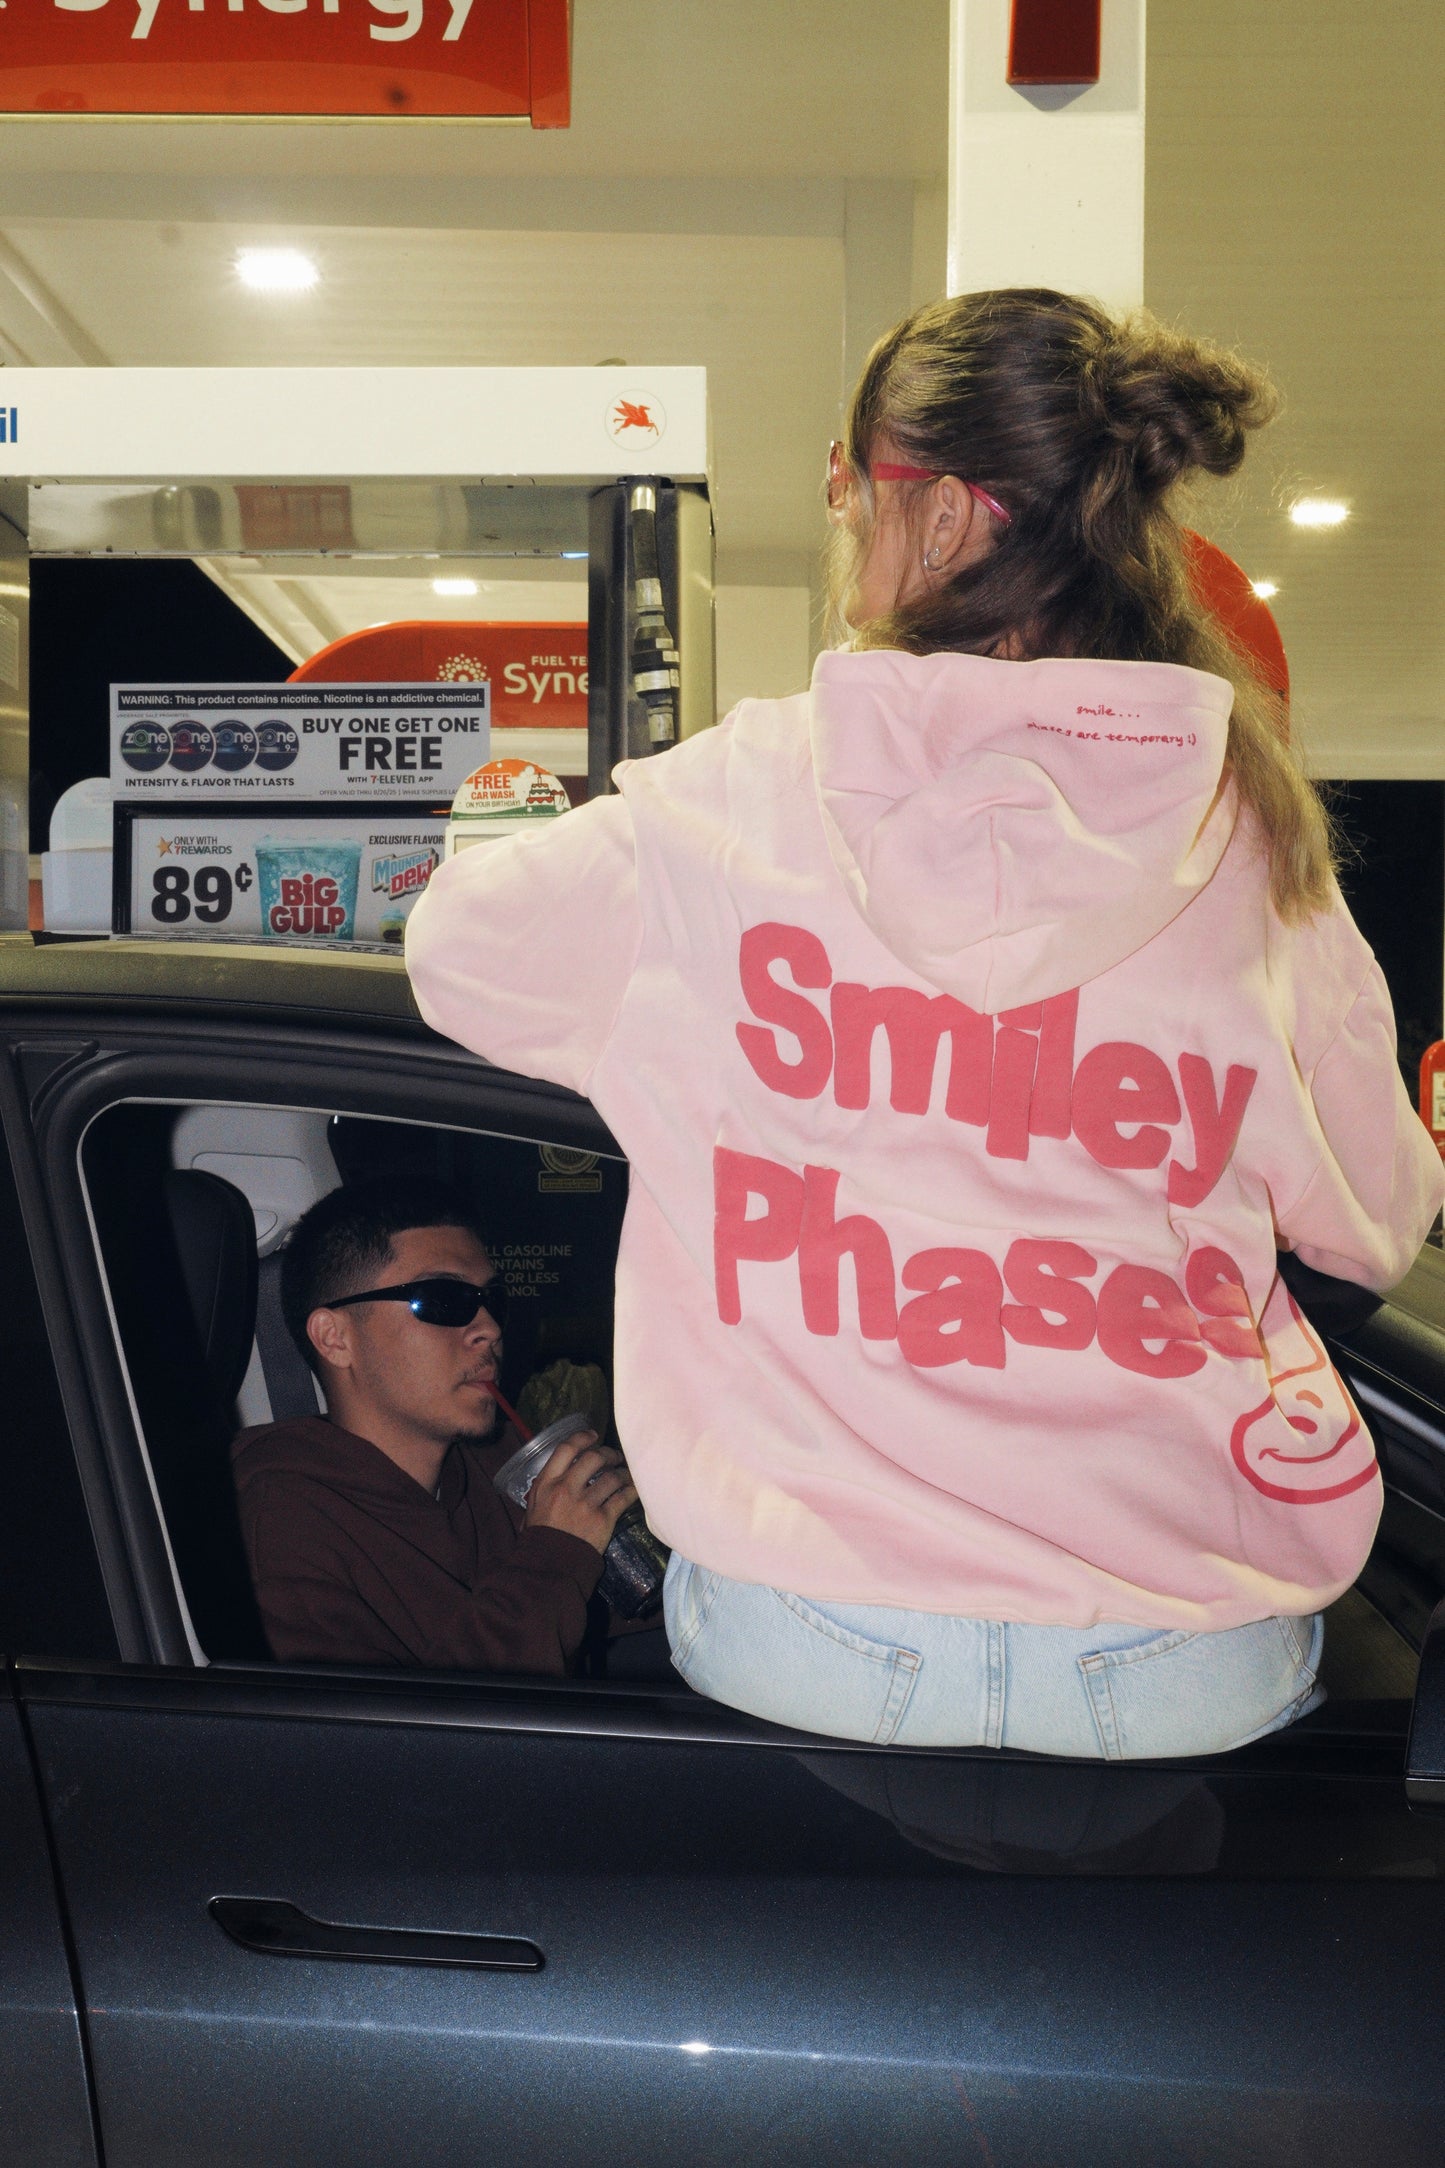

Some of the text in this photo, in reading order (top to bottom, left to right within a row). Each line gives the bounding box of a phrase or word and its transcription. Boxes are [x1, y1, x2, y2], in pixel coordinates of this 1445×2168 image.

[531, 655, 588, 666] FUEL TE
[121, 695, 173, 705] WARNING:
[175, 695, 196, 704] This
[198, 695, 236, 707] product
[237, 695, 279, 704] contains
[280, 694, 322, 704] nicotine.
[324, 694, 364, 703] Nicotine
[365, 694, 374, 703] is
[390, 694, 435, 703] addictive
[436, 693, 483, 703] chemical.
[302, 717, 480, 734] BUY ONE GET ONE
[1076, 731, 1101, 741] are
[1104, 733, 1184, 747] temporary
[339, 736, 443, 770] FREE
[125, 777, 295, 787] INTENSITY & FLAVOR THAT LASTS
[418, 775, 434, 783] APP
[474, 774, 512, 790] FREE
[471, 789, 516, 800] CAR WASH
[466, 800, 475, 809] ON
[475, 800, 491, 808] YOUR
[174, 836, 218, 845] ONLY WITH
[369, 835, 412, 845] EXCLUSIVE
[270, 905, 346, 935] GULP
[735, 922, 1258, 1208] Smiley
[484, 1244, 573, 1257] LL GASOLINE
[491, 1258, 545, 1270] NTAINS
[713, 1145, 1266, 1379] Phases
[504, 1271, 560, 1284] OR LESS
